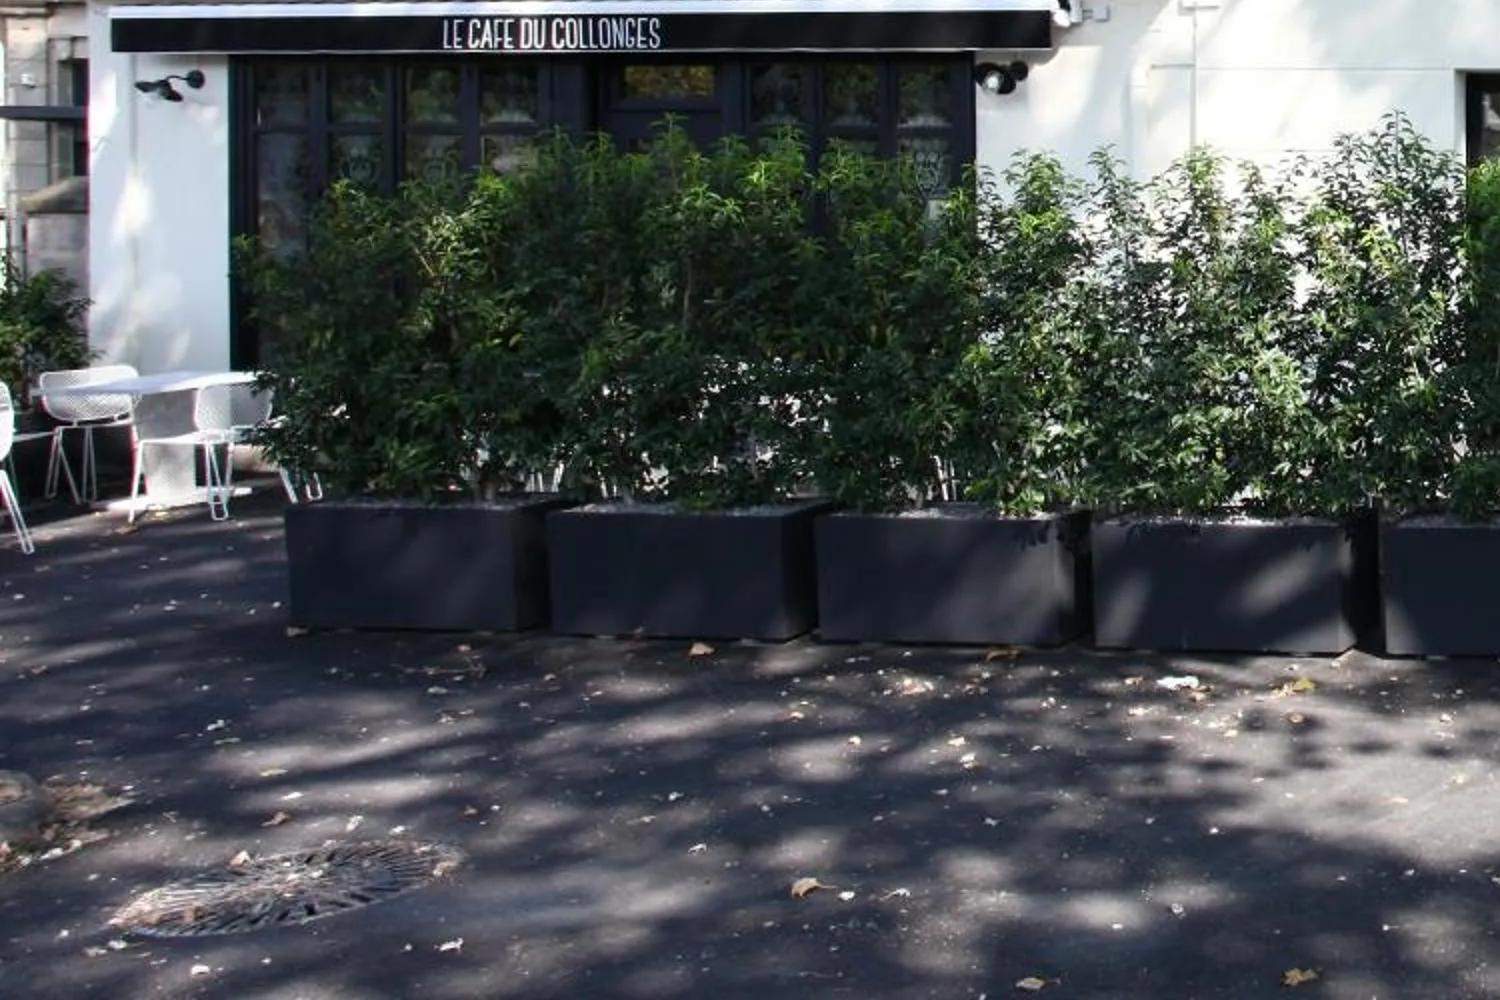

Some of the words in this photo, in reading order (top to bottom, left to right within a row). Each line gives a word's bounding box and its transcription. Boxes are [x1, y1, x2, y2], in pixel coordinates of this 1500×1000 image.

[443, 19, 463, 49] LE
[468, 18, 515, 49] CAFE
[520, 18, 546, 49] DU
[551, 17, 662, 49] COLLONGES
